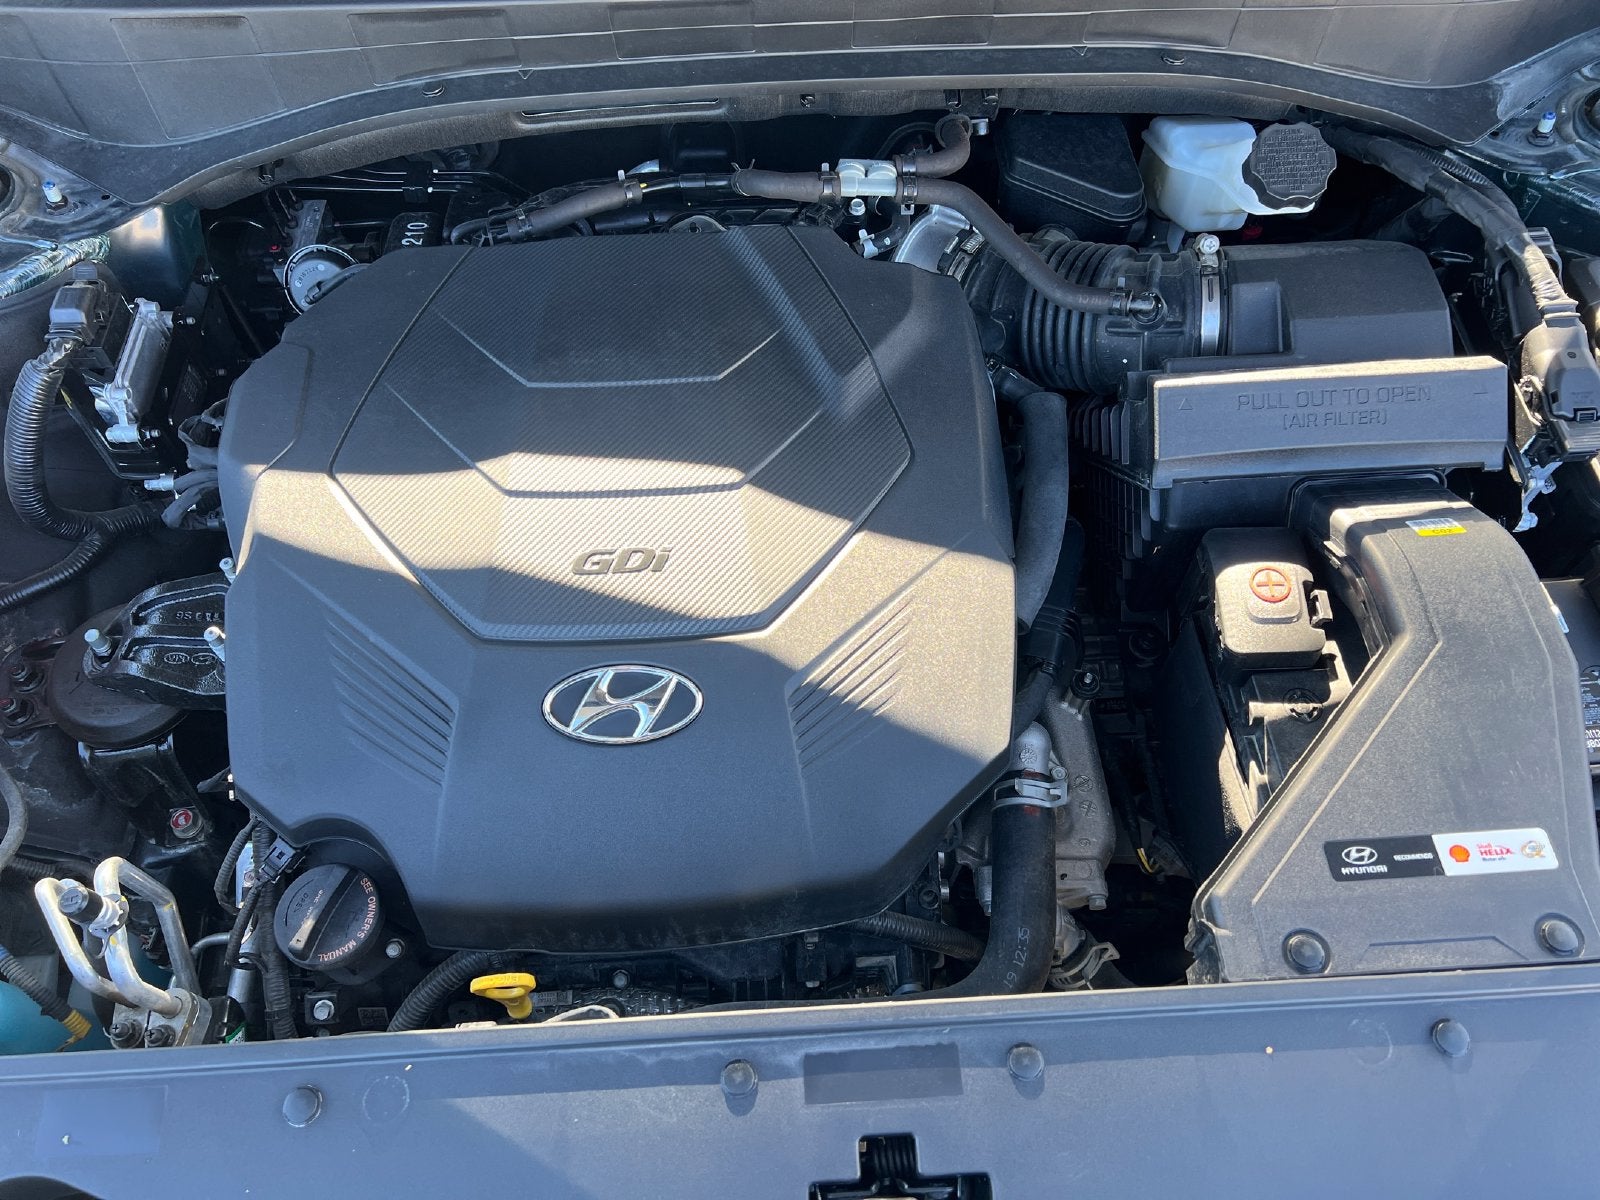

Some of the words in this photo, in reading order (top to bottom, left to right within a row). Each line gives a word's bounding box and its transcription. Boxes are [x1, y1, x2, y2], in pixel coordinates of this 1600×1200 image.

[1237, 393, 1289, 410] PULL
[1296, 389, 1338, 408] OUT
[1342, 388, 1370, 406] TO
[1377, 385, 1432, 404] OPEN
[572, 547, 673, 575] GDi
[1480, 847, 1513, 857] HELIX
[1341, 865, 1388, 875] HYUNDAI
[360, 877, 374, 894] SEE
[318, 939, 357, 962] MANUAL
